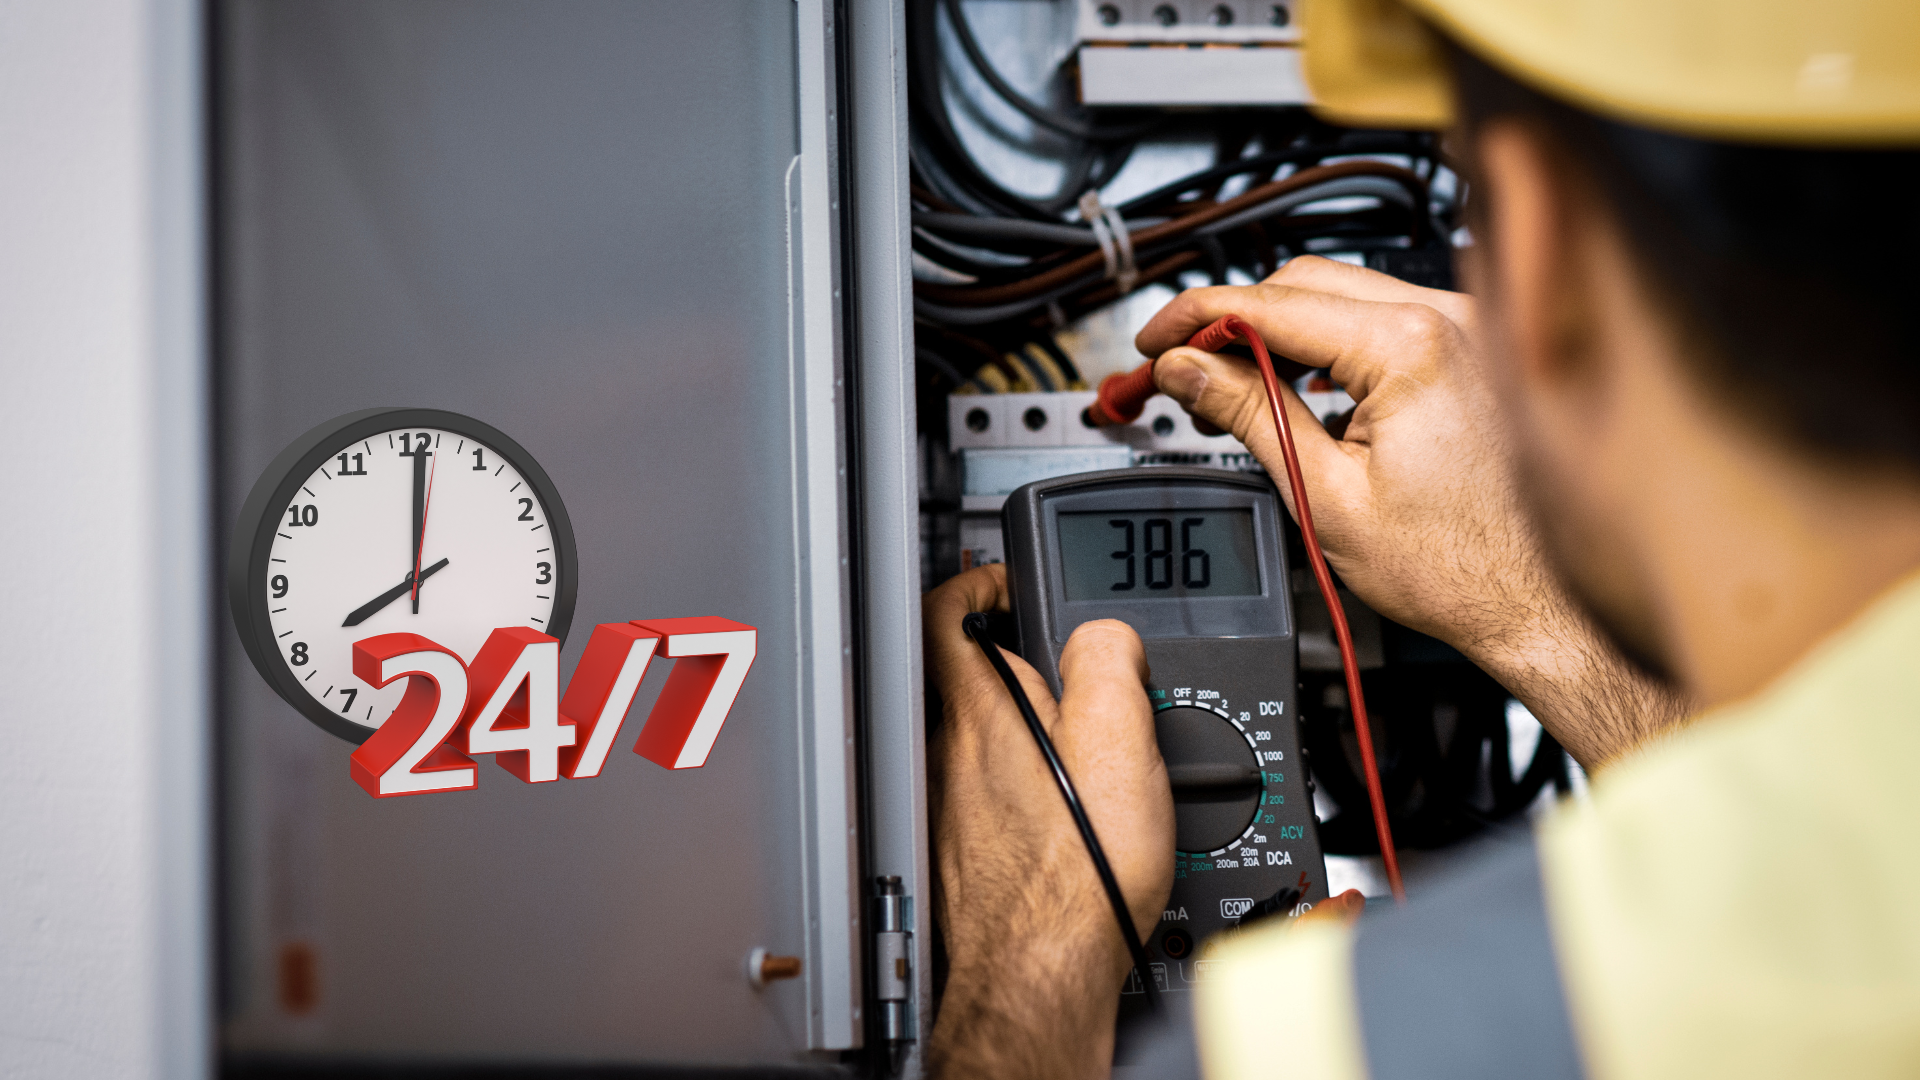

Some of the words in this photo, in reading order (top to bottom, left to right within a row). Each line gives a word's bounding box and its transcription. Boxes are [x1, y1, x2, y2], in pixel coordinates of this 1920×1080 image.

[1108, 518, 1211, 591] 386
[1173, 688, 1192, 698] OFF
[1196, 690, 1220, 699] 200m
[1222, 700, 1229, 709] 2
[1259, 701, 1284, 716] DCV
[1240, 712, 1251, 721] 20
[1255, 731, 1271, 741] 200
[1264, 751, 1284, 761] 1000
[1269, 773, 1284, 783] 750
[1269, 795, 1285, 805] 200
[1265, 814, 1275, 824] 20
[1281, 826, 1304, 839] ACV
[1254, 834, 1267, 843] 2m
[1241, 848, 1258, 857] 20m
[1243, 858, 1260, 867] 20A
[1266, 851, 1292, 866] DCA
[1191, 862, 1213, 871] 200m
[1216, 859, 1239, 869] 200m
[1224, 901, 1251, 915] COM
[1163, 907, 1189, 921] mA
